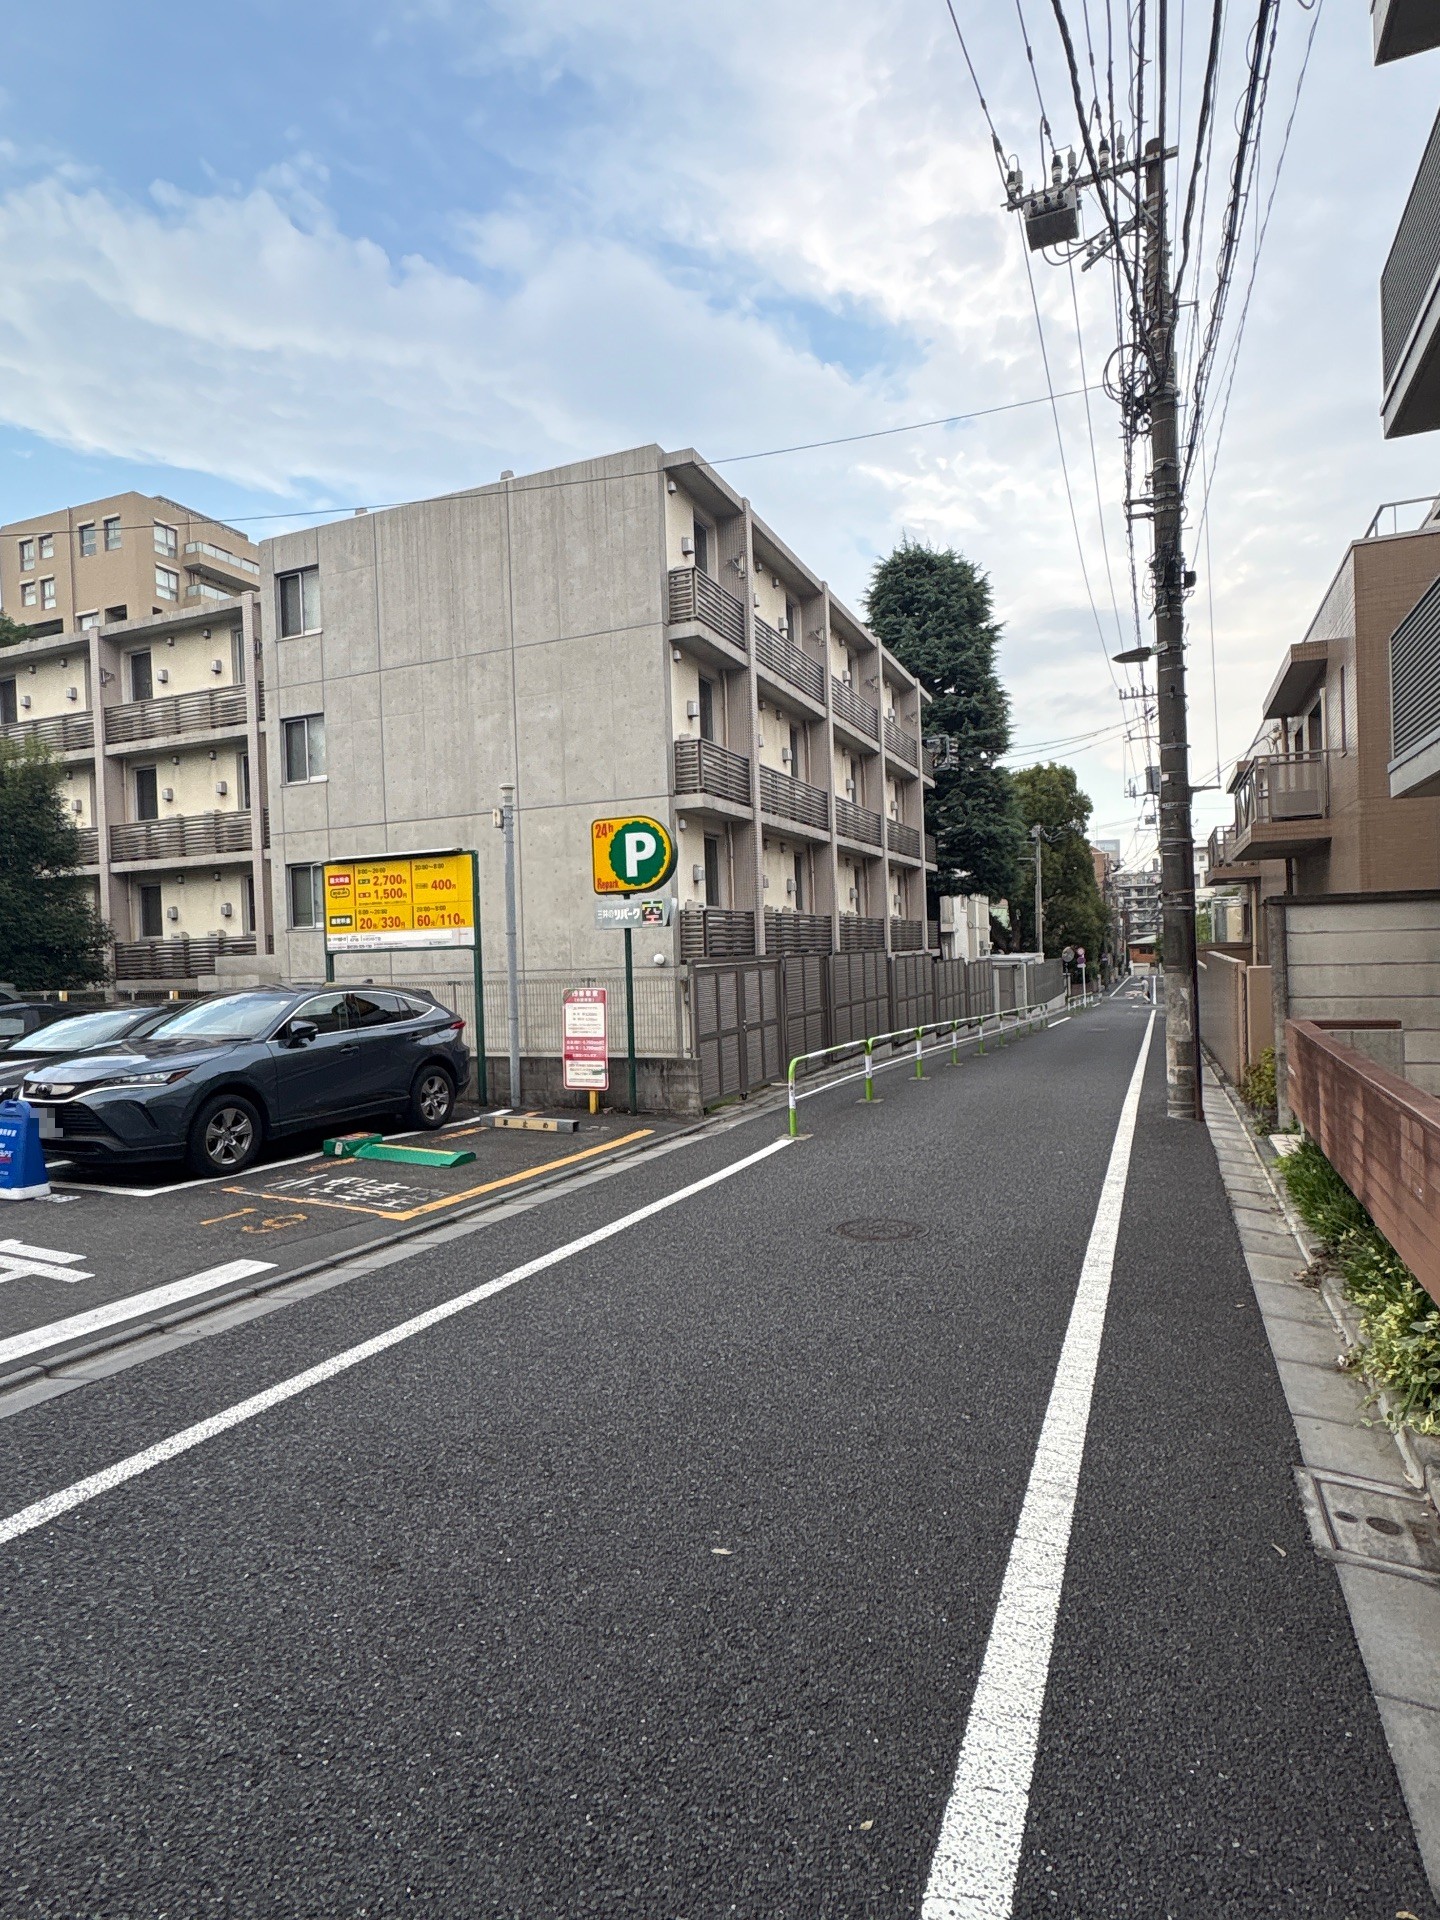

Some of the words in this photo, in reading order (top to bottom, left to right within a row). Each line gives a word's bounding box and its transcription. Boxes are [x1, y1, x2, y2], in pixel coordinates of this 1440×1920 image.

[624, 831, 657, 878] P
[431, 878, 457, 891] 400円
[597, 907, 640, 921] 三井のリパーク
